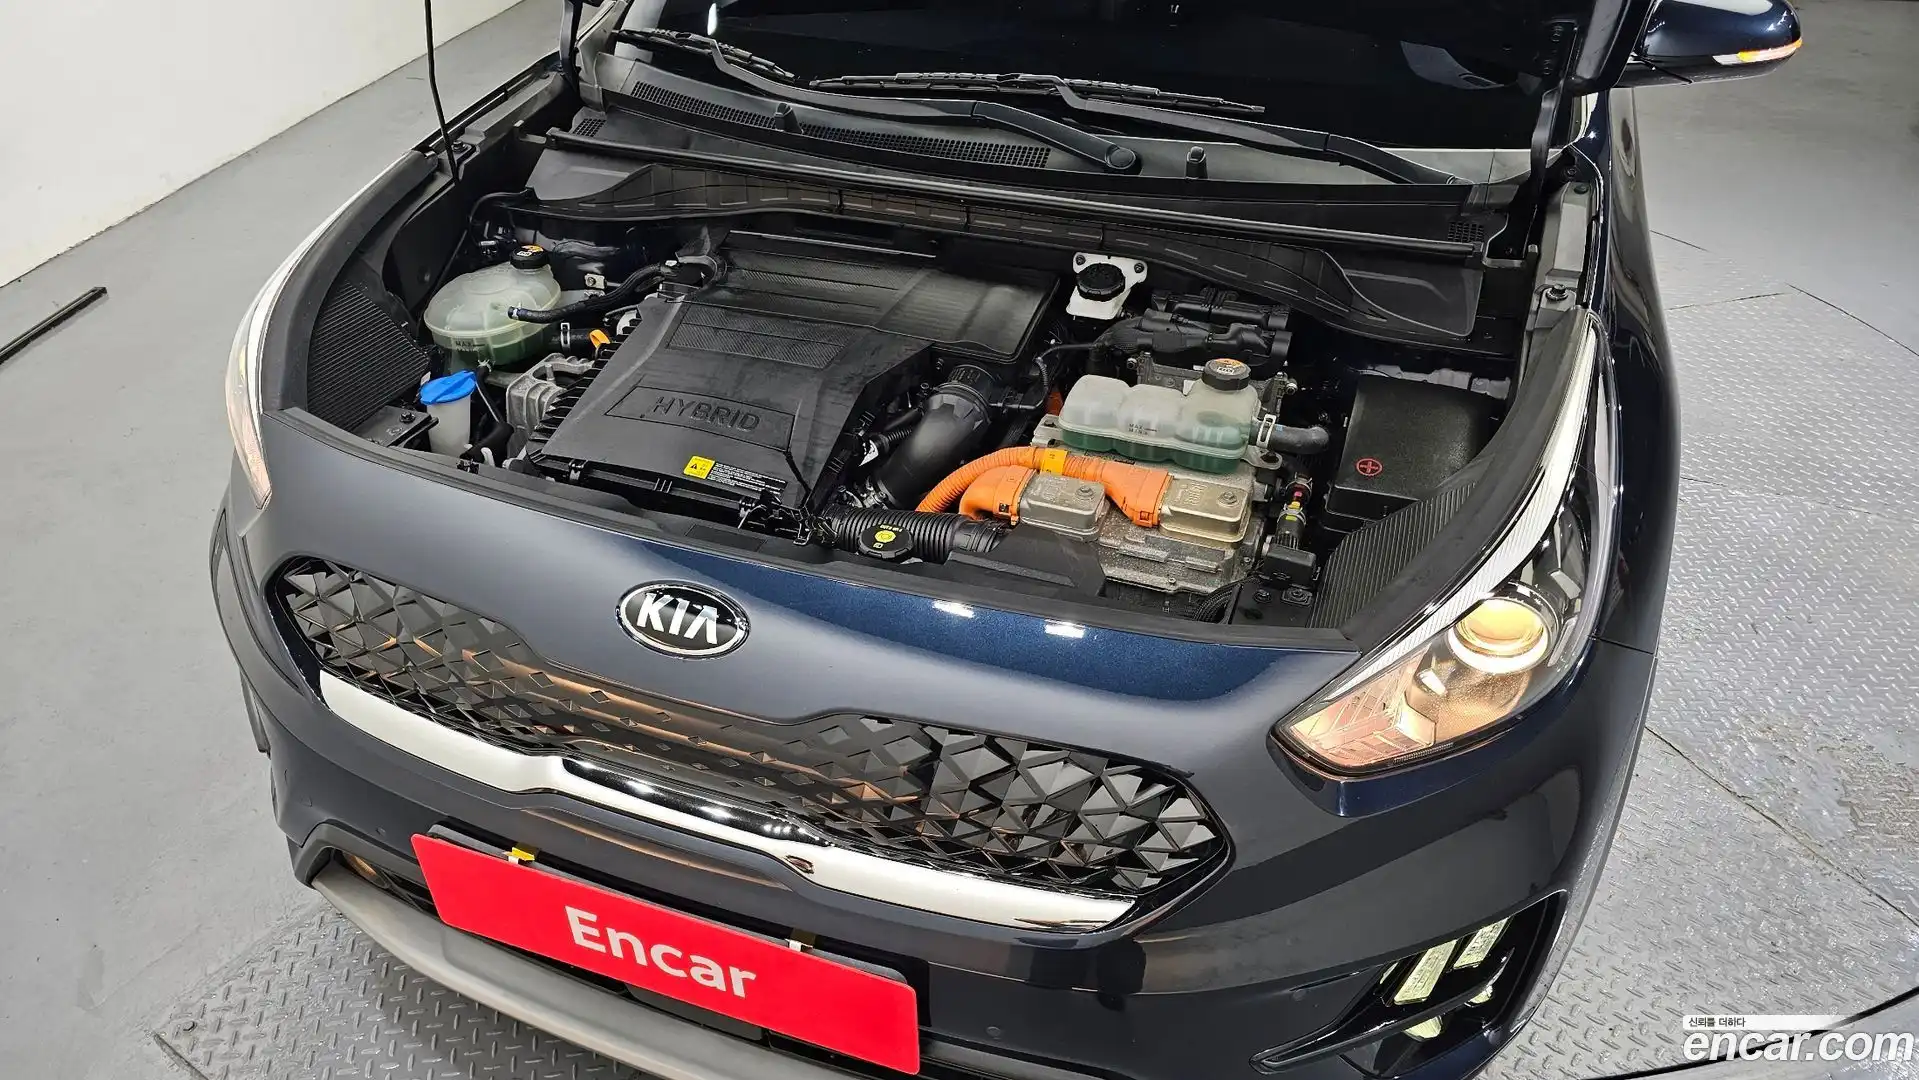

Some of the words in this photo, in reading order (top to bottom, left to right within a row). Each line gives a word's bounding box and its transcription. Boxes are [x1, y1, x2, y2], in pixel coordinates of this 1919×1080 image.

[652, 396, 760, 432] HYBRID
[636, 592, 719, 645] KIA
[564, 905, 757, 998] Encar
